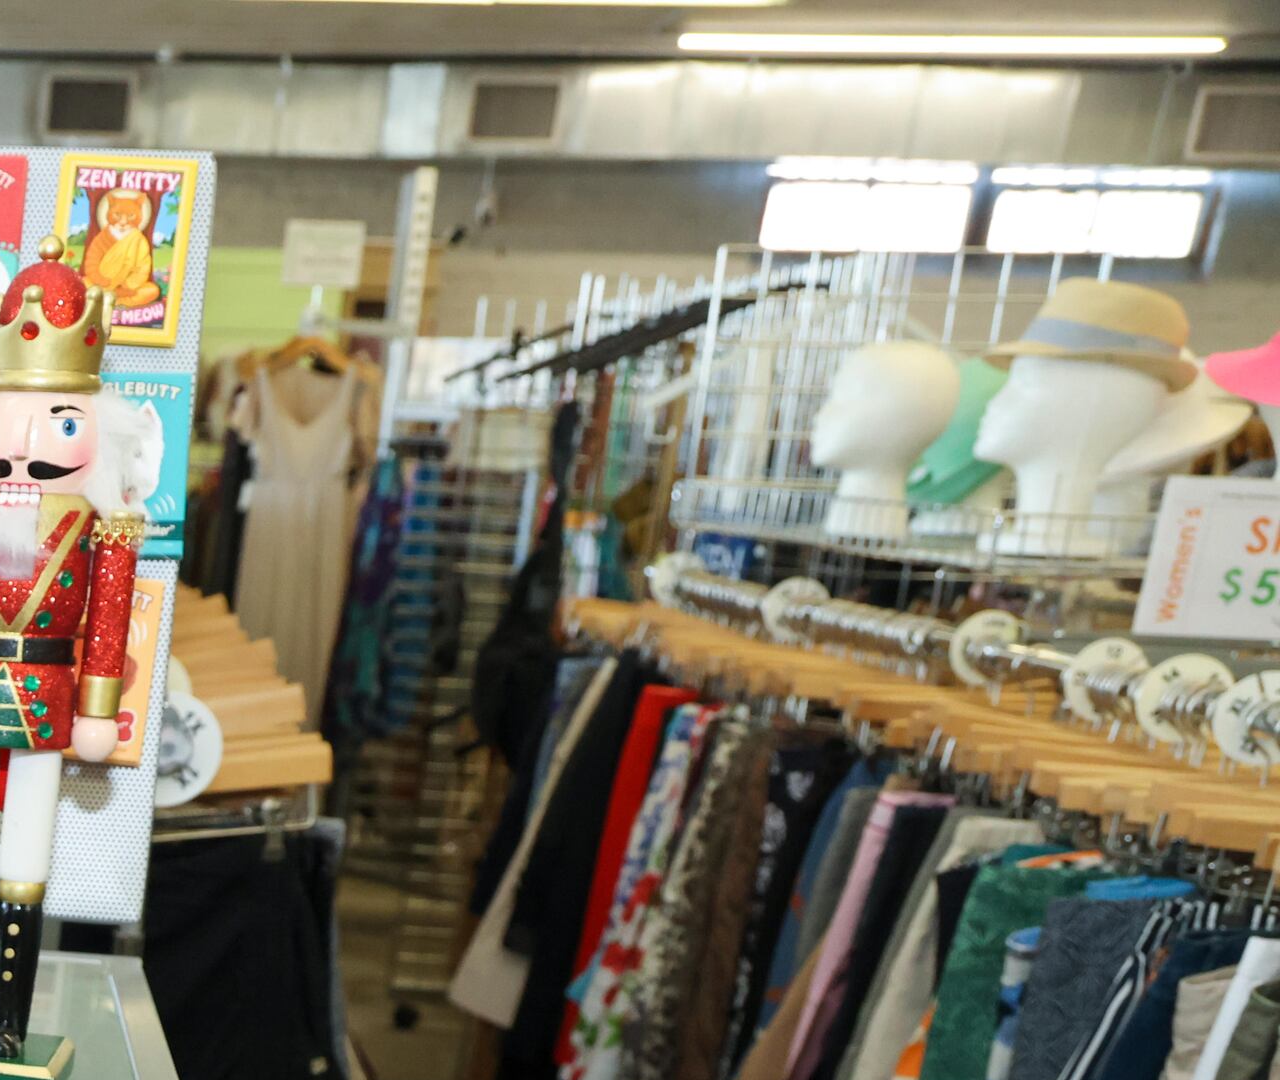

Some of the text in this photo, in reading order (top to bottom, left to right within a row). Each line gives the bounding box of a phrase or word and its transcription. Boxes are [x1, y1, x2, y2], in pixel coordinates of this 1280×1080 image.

[76, 168, 181, 192] ZEN KITTY
[120, 304, 164, 325] MEOW
